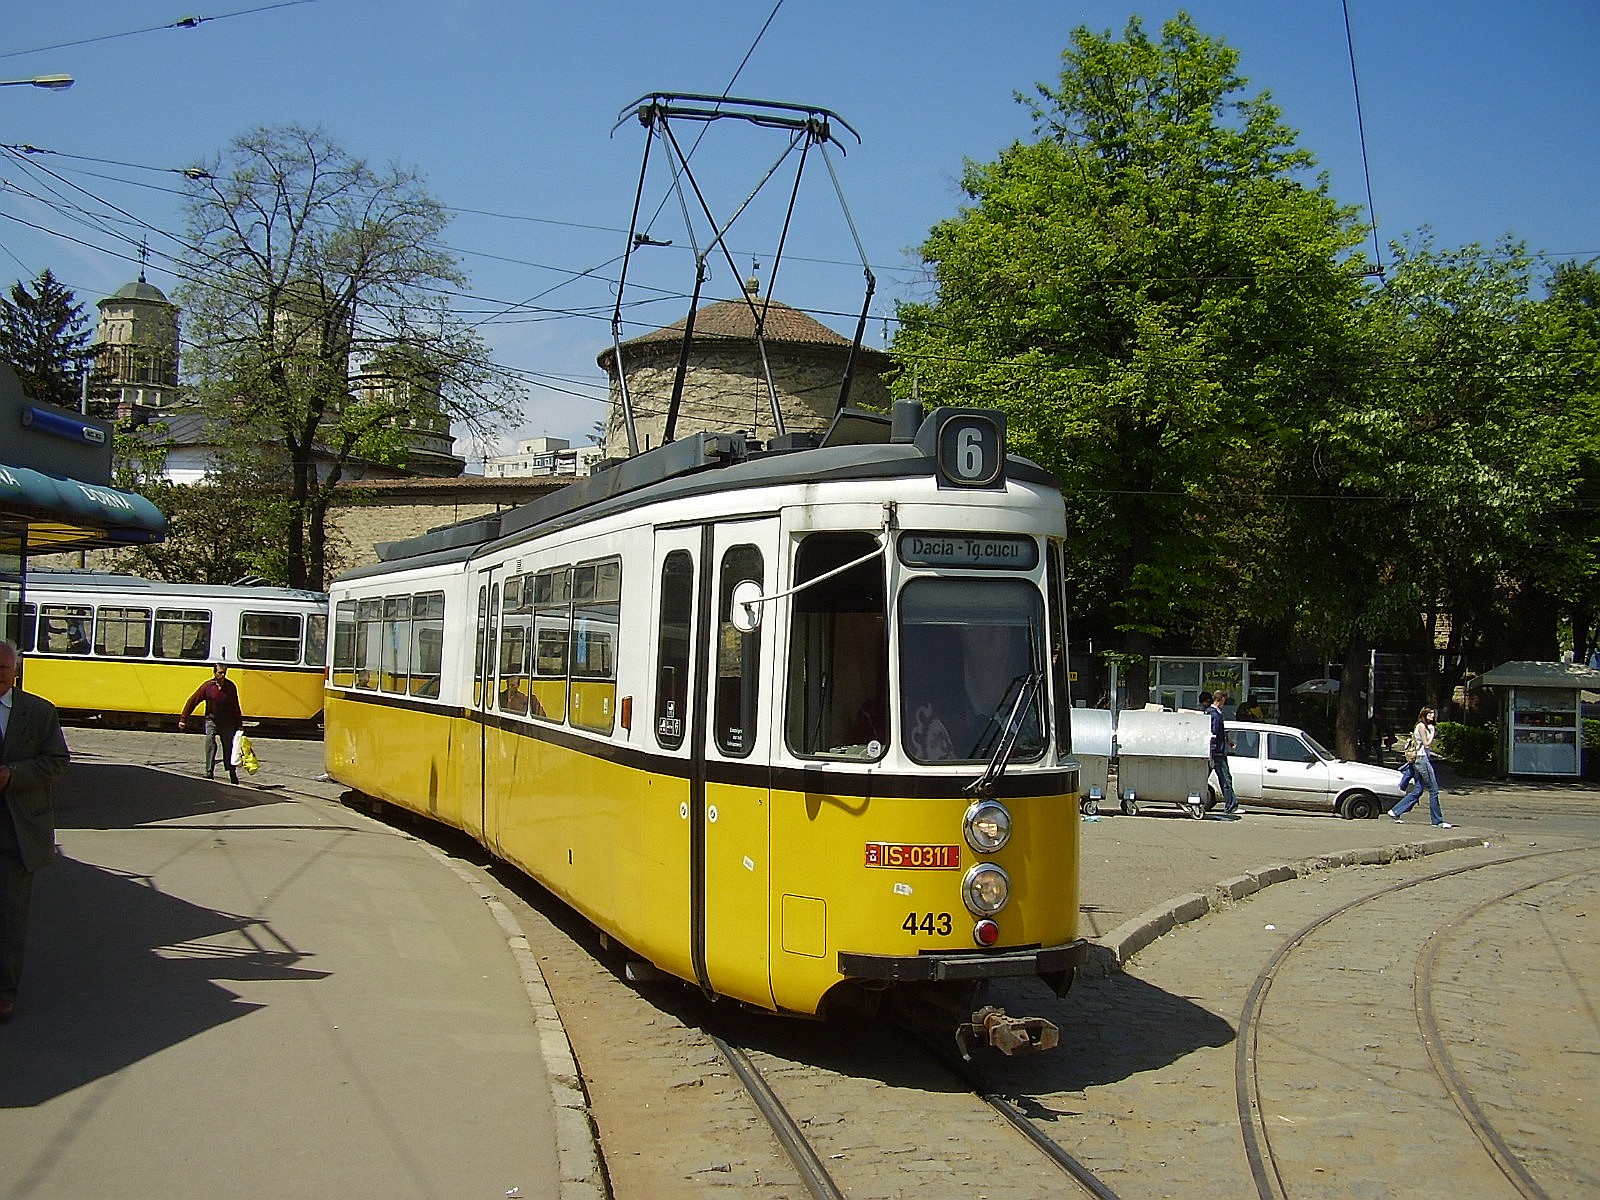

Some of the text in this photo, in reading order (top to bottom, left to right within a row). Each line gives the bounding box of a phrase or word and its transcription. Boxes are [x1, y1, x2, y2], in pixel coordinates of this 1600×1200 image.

[957, 427, 983, 478] 6
[912, 538, 954, 556] Dacia
[884, 845, 949, 866] IS-0311
[901, 911, 953, 937] 443
